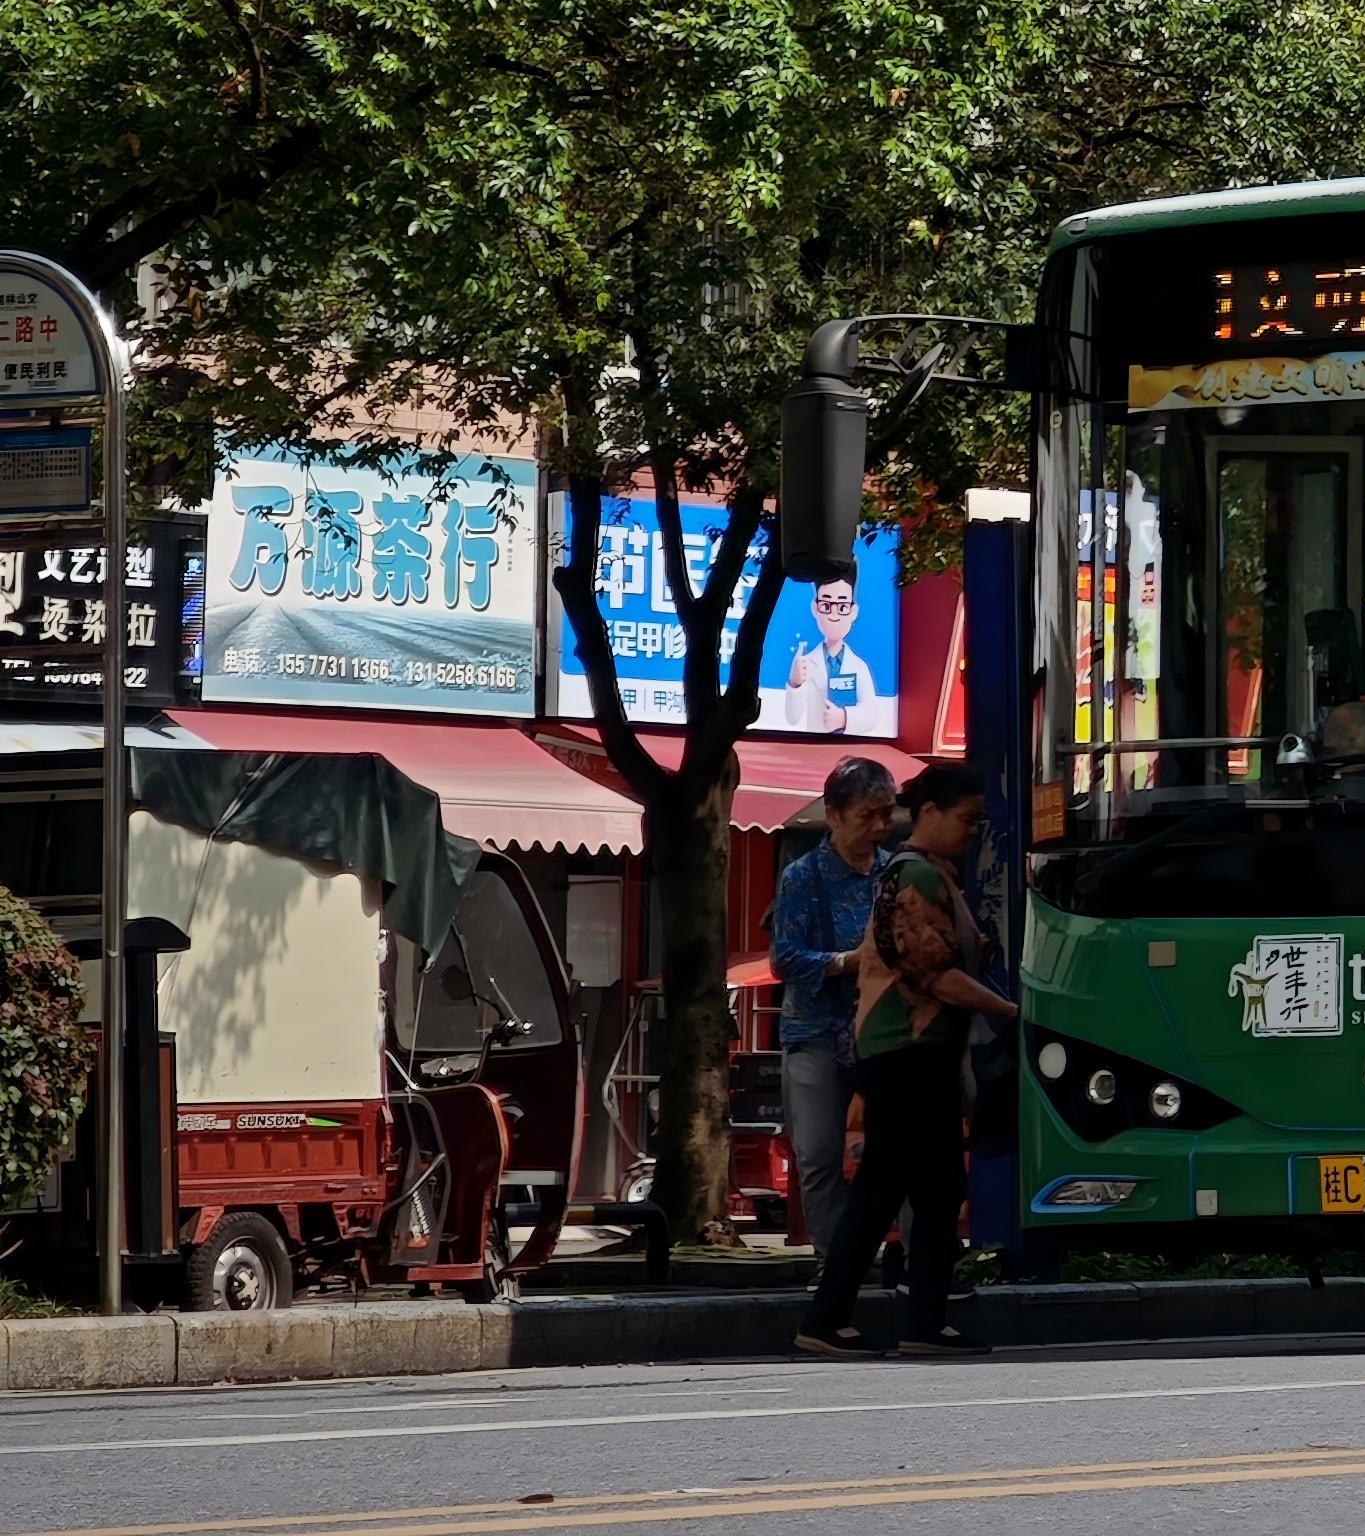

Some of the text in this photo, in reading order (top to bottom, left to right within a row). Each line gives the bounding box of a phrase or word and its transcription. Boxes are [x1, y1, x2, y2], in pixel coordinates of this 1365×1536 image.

[228, 485, 500, 610] 万源茶行
[308, 654, 347, 677] 7731
